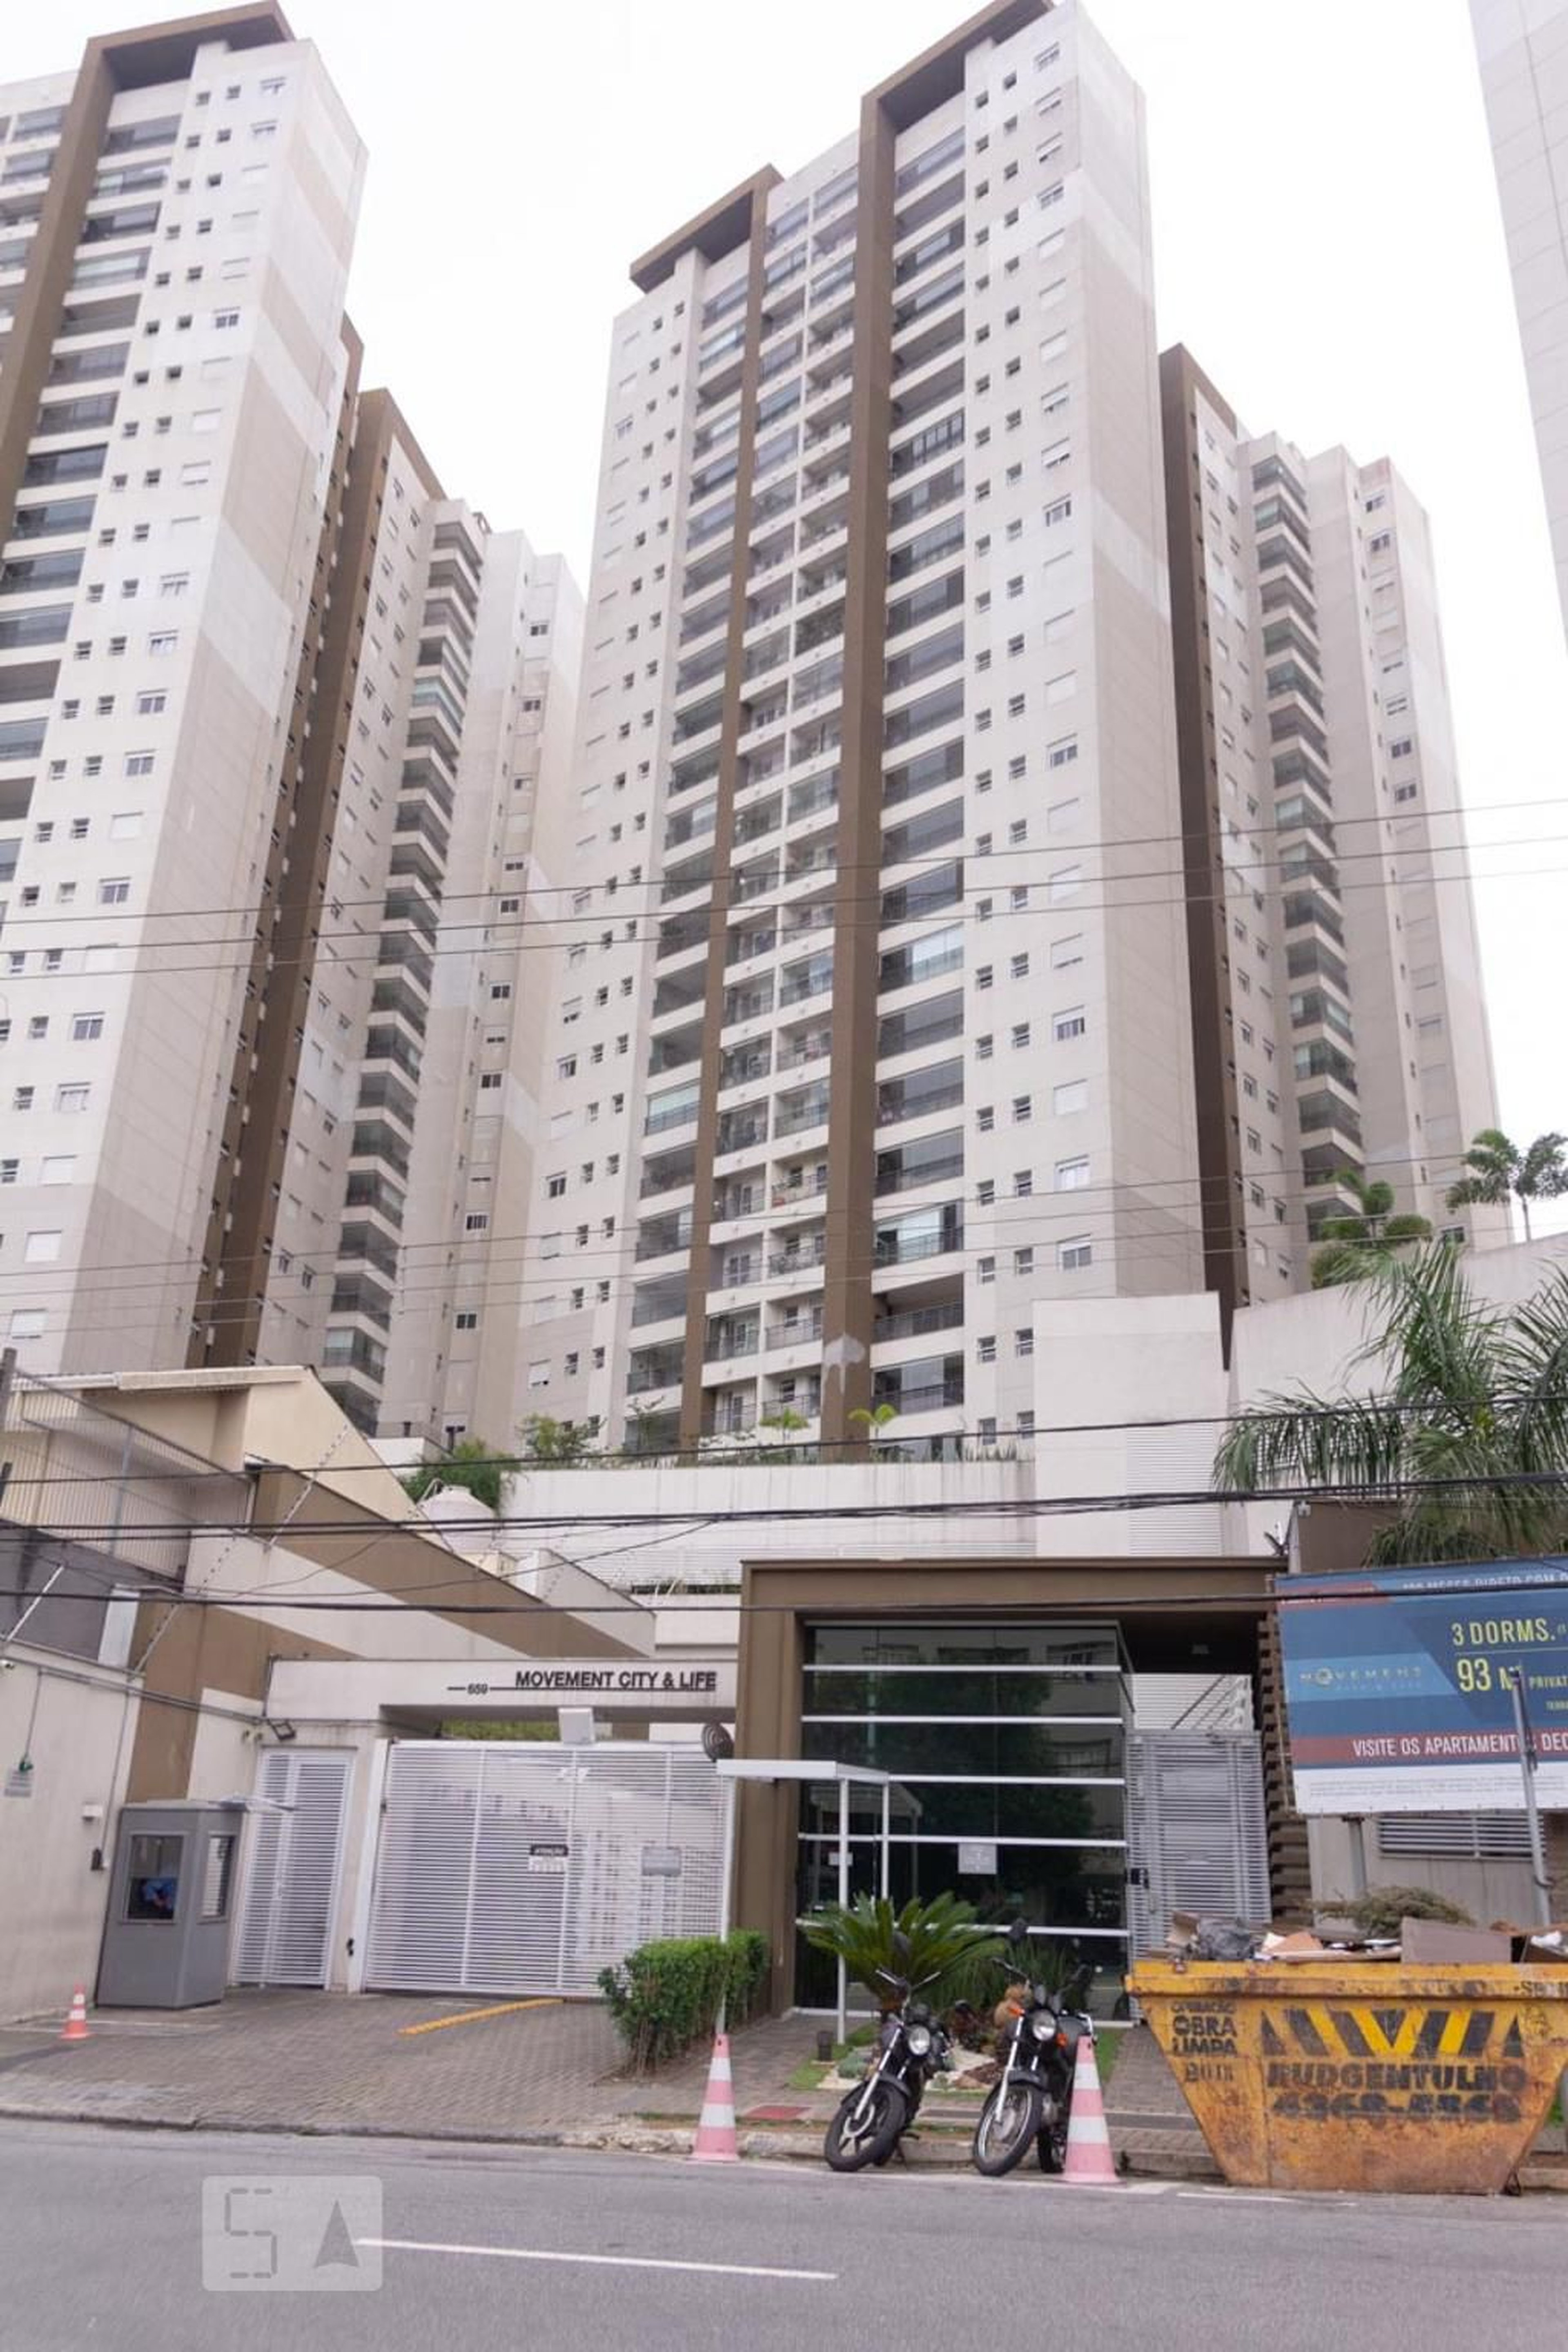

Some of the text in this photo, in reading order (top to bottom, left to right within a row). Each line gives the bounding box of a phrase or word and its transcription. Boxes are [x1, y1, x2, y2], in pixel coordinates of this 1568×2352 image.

[1452, 1623, 1464, 1646] 3
[1470, 1617, 1556, 1645] DORMS.
[516, 1671, 717, 1687] MOVEMENT CITY & LIFE
[1457, 1658, 1492, 1691] 93
[1353, 1737, 1397, 1757] VISITE
[1401, 1738, 1420, 1755] OS
[1173, 2015, 1238, 2037] OBRA
